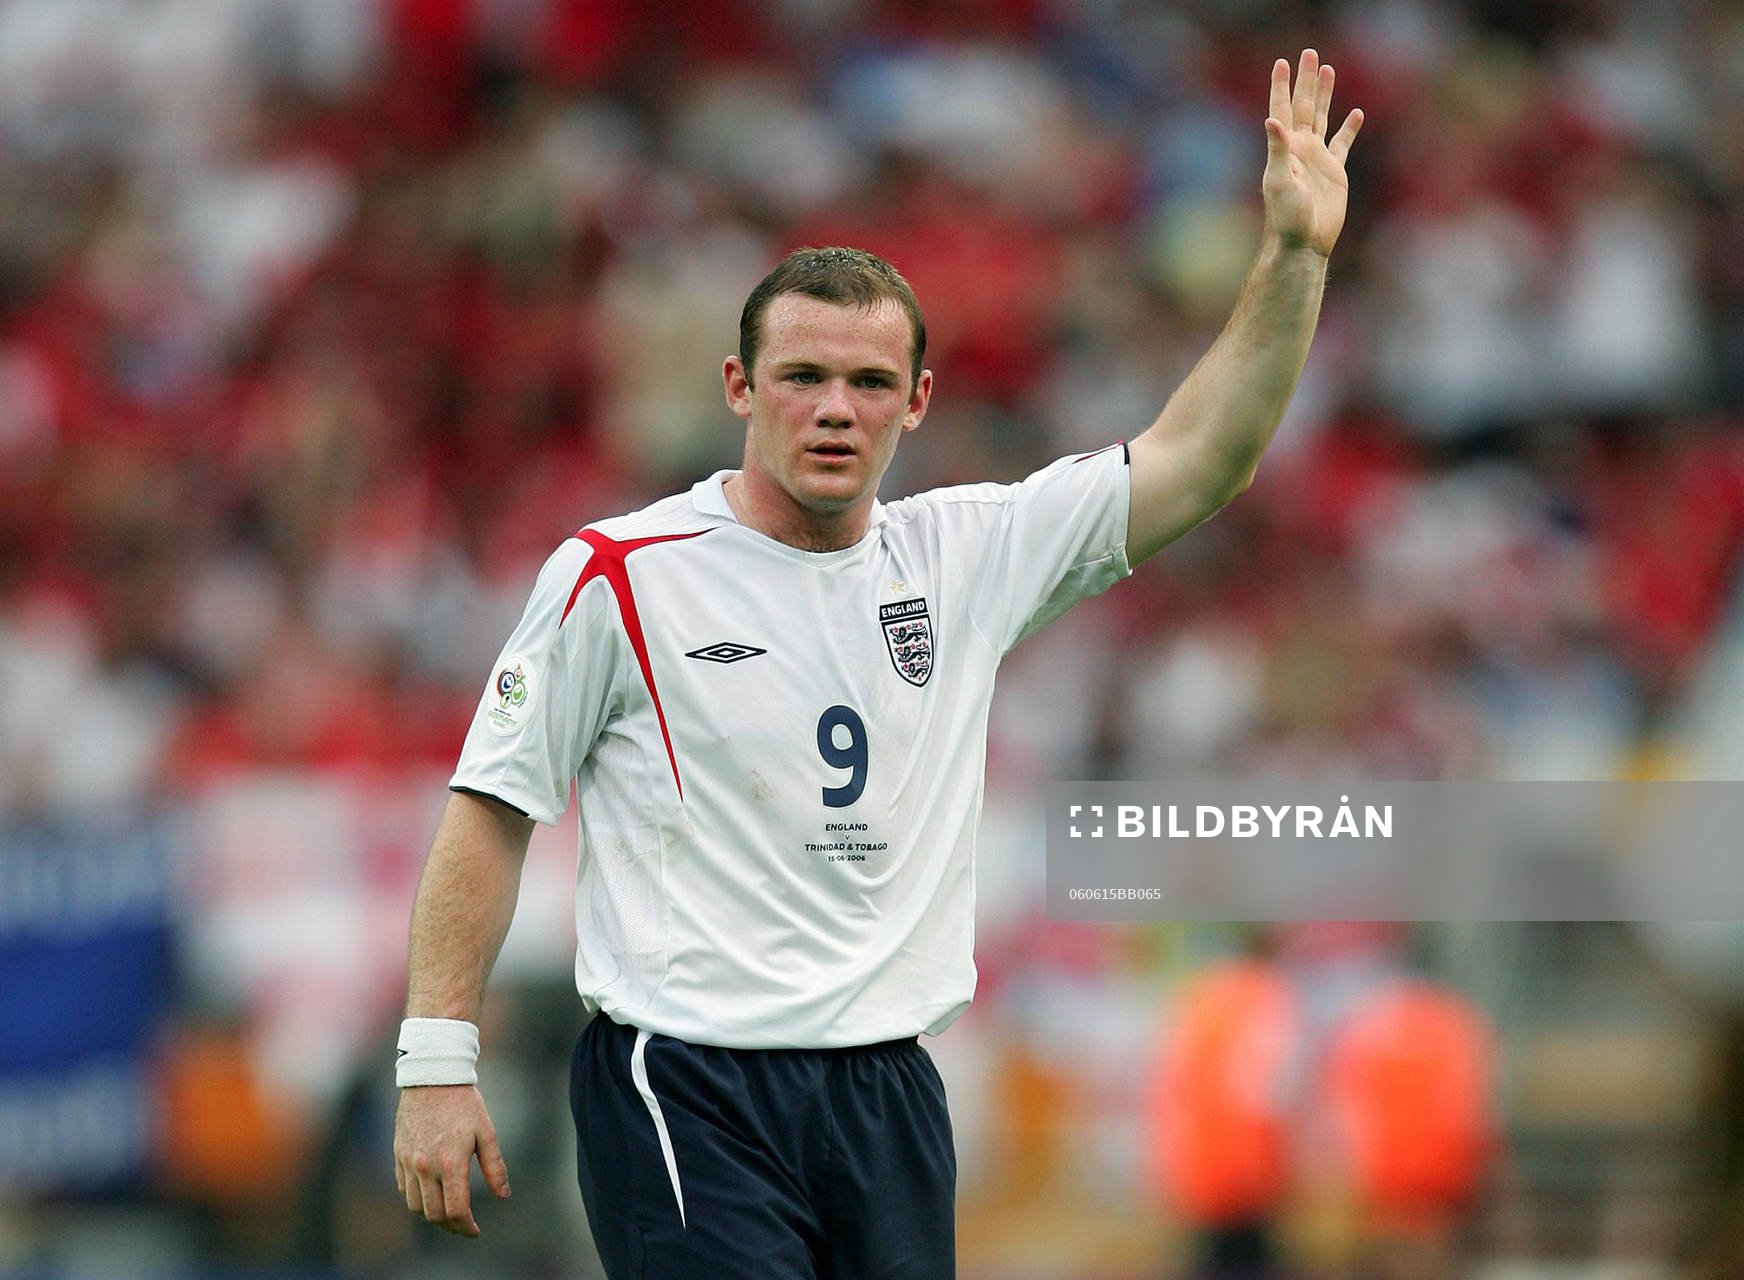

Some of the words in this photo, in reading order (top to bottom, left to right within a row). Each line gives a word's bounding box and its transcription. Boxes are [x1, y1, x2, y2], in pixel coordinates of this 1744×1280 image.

[881, 601, 925, 618] ENGLAND
[817, 705, 868, 807] 9
[825, 823, 868, 831] ENGLAND
[847, 843, 853, 851] &
[855, 843, 888, 851] TOBAGO
